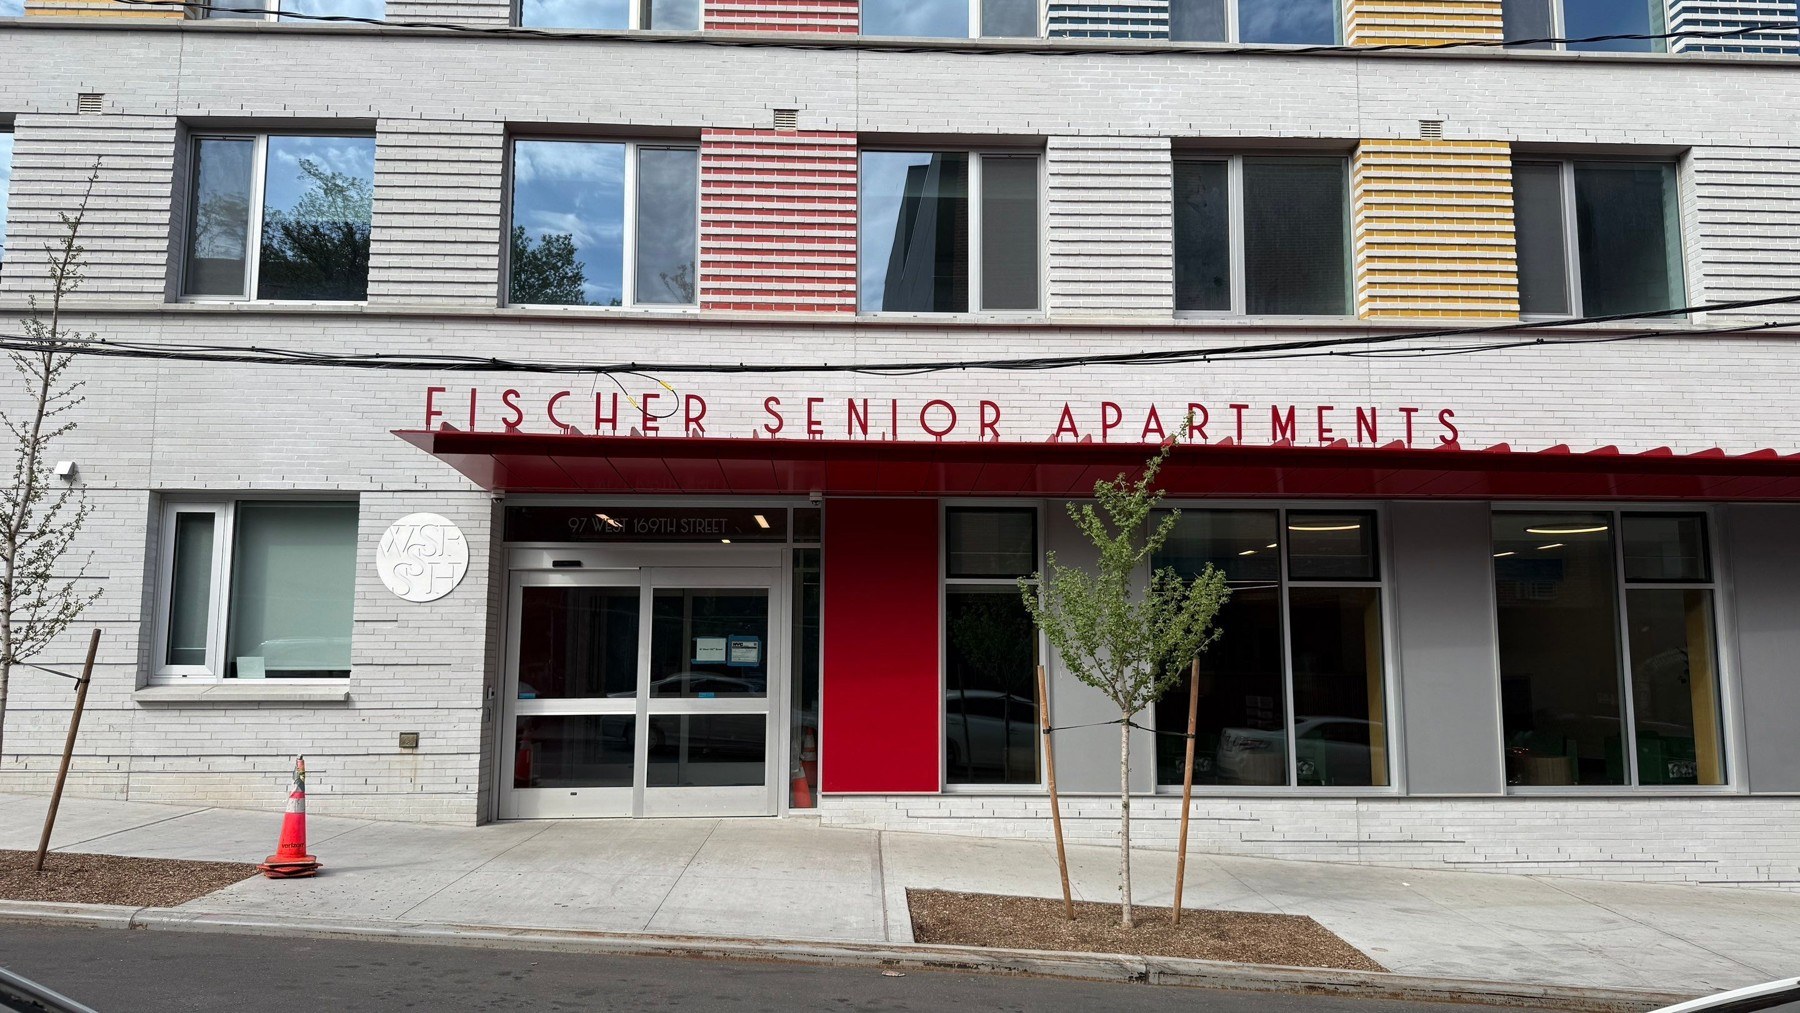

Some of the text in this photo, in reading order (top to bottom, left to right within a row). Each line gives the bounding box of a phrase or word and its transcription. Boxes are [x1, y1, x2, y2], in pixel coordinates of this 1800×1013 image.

[426, 387, 1459, 445] FISCHER SENIOR APARTMENTS
[568, 517, 728, 534] 97 WEST 169TH STREET
